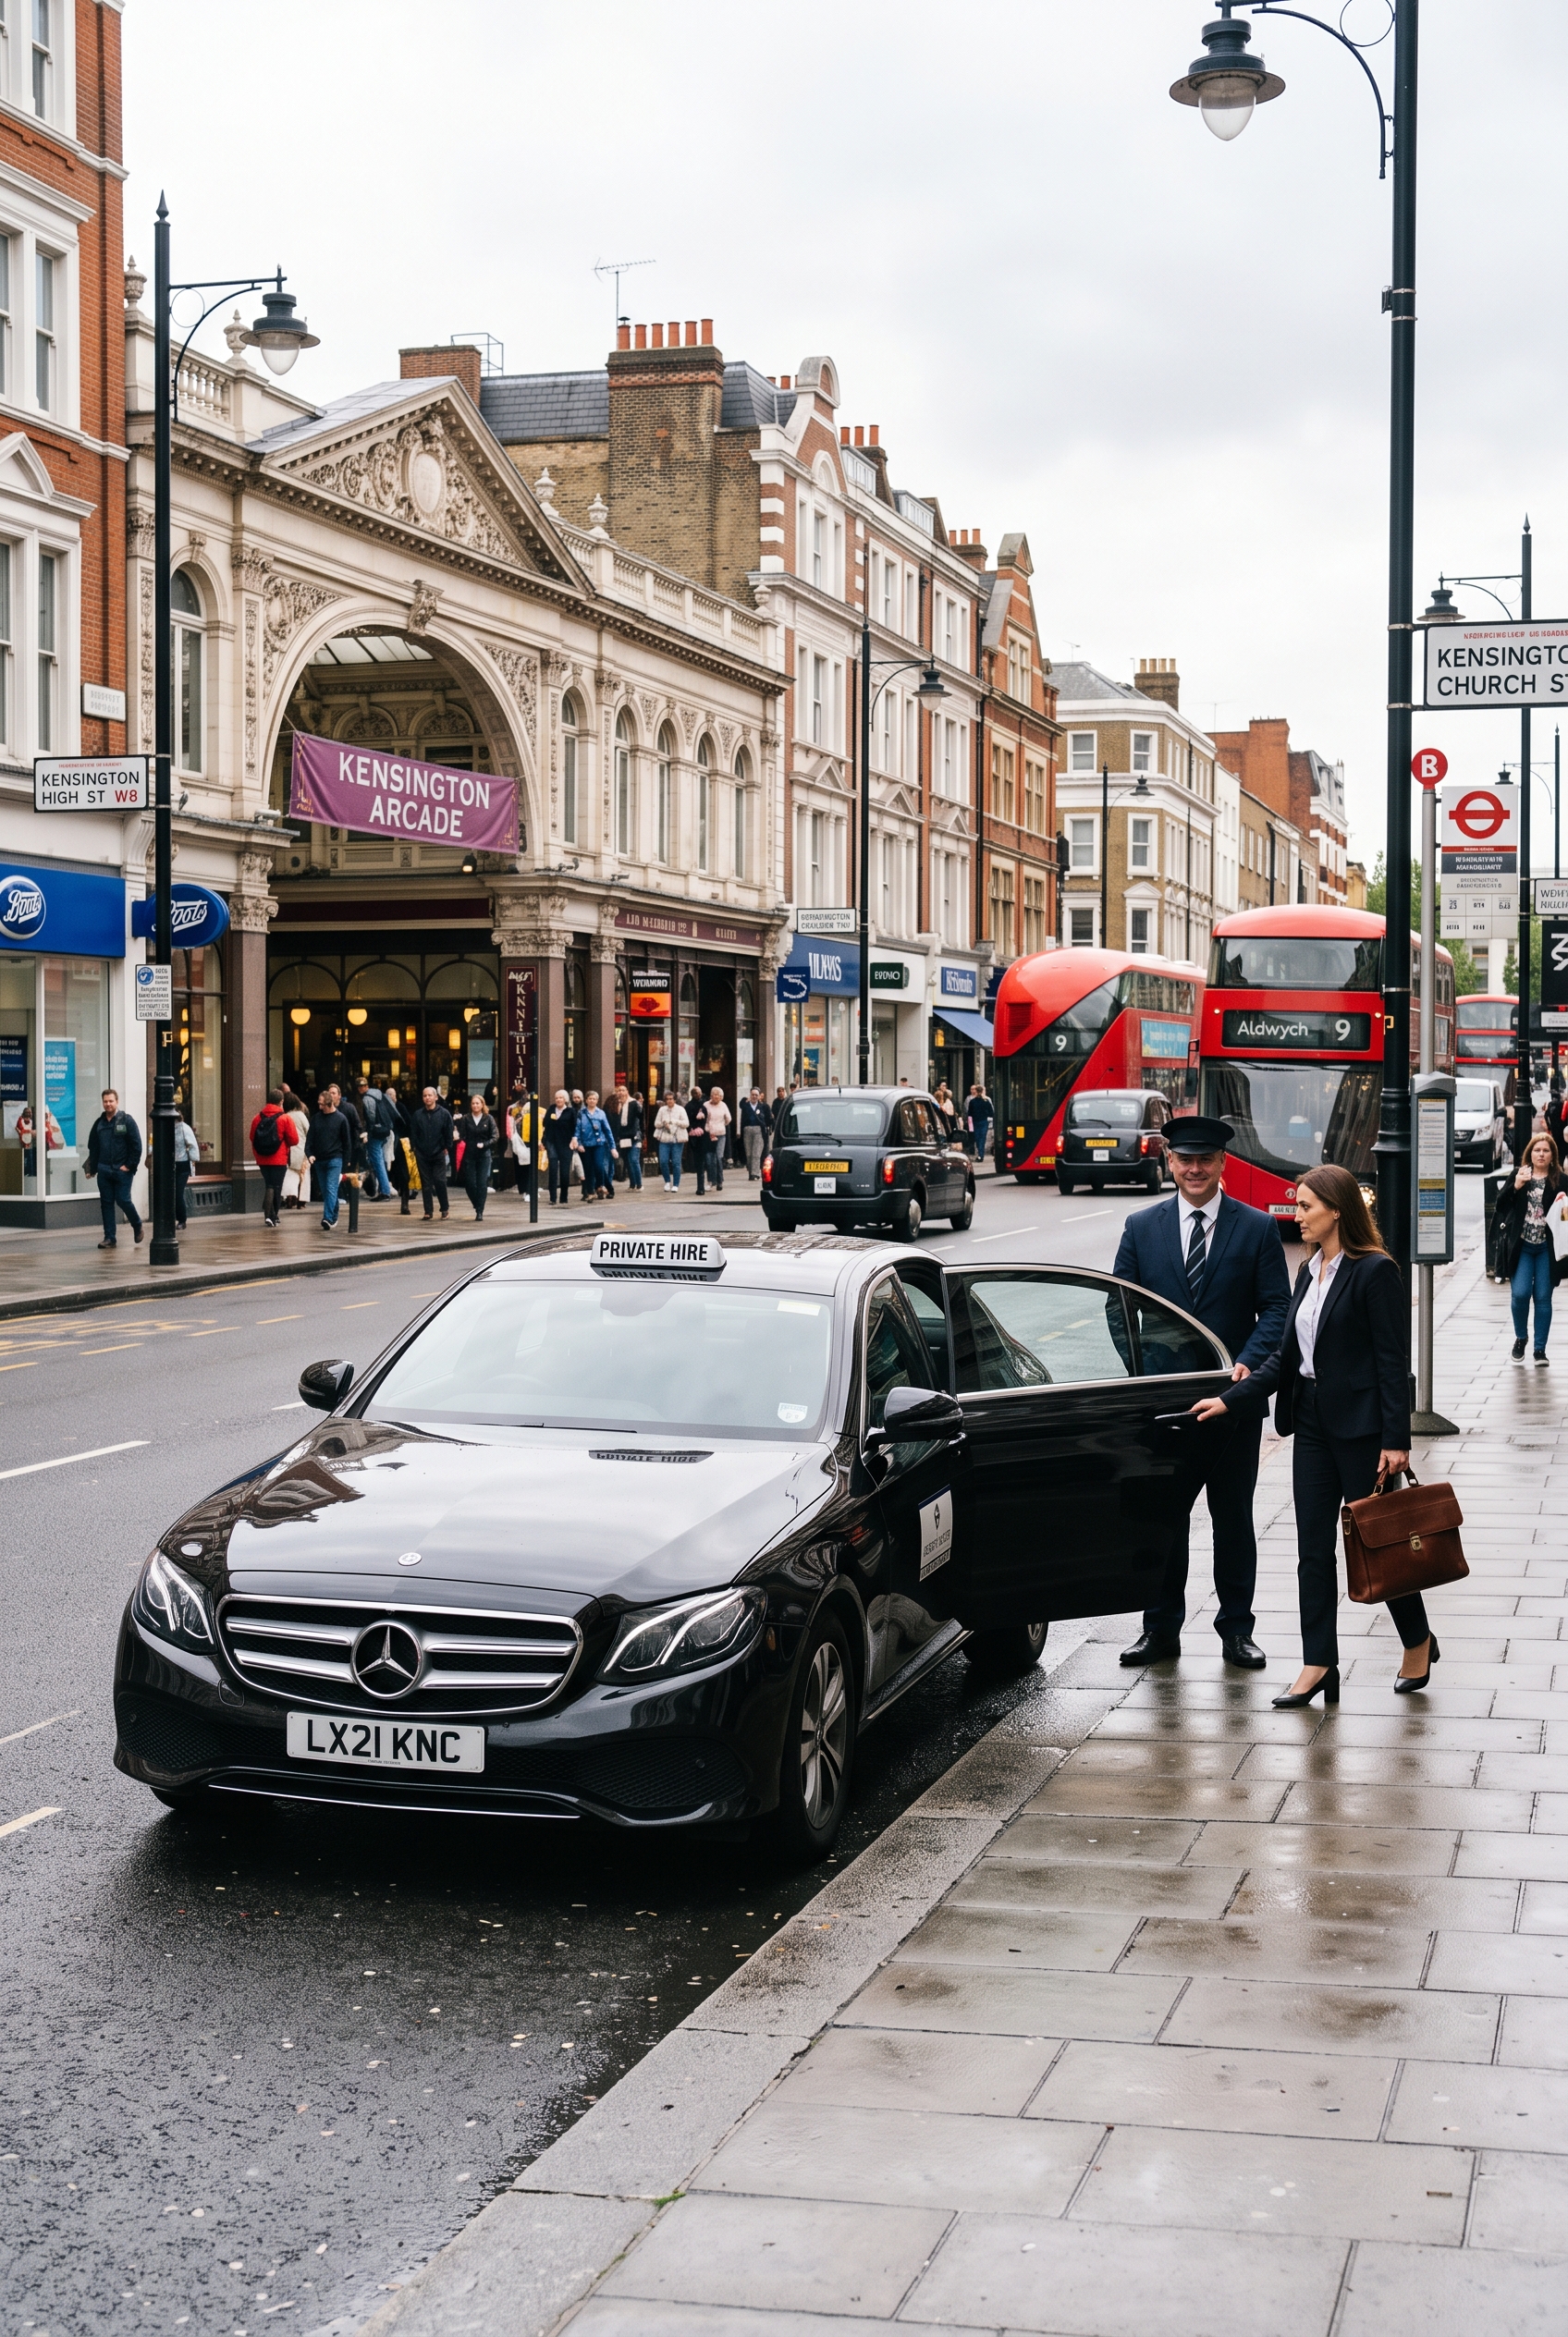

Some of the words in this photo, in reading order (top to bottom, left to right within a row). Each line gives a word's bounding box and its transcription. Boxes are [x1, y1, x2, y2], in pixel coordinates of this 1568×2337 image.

[1437, 674, 1537, 696] CHURCH
[1550, 673, 1568, 693] S
[1421, 754, 1439, 777] B
[42, 771, 140, 787] KENSINGTON
[338, 752, 490, 810] KENSINGTON
[42, 790, 79, 804] HIGH
[87, 789, 105, 803] ST
[115, 789, 138, 803] W8
[369, 795, 464, 838] ARCADE
[1237, 1021, 1308, 1040] Aldwych
[1334, 1019, 1351, 1041] 9
[1055, 1034, 1068, 1052] 9
[599, 1241, 666, 1259] PRIVATE
[670, 1243, 708, 1261] HIRE
[307, 1719, 381, 1758] LX21
[392, 1727, 461, 1764] KNC
